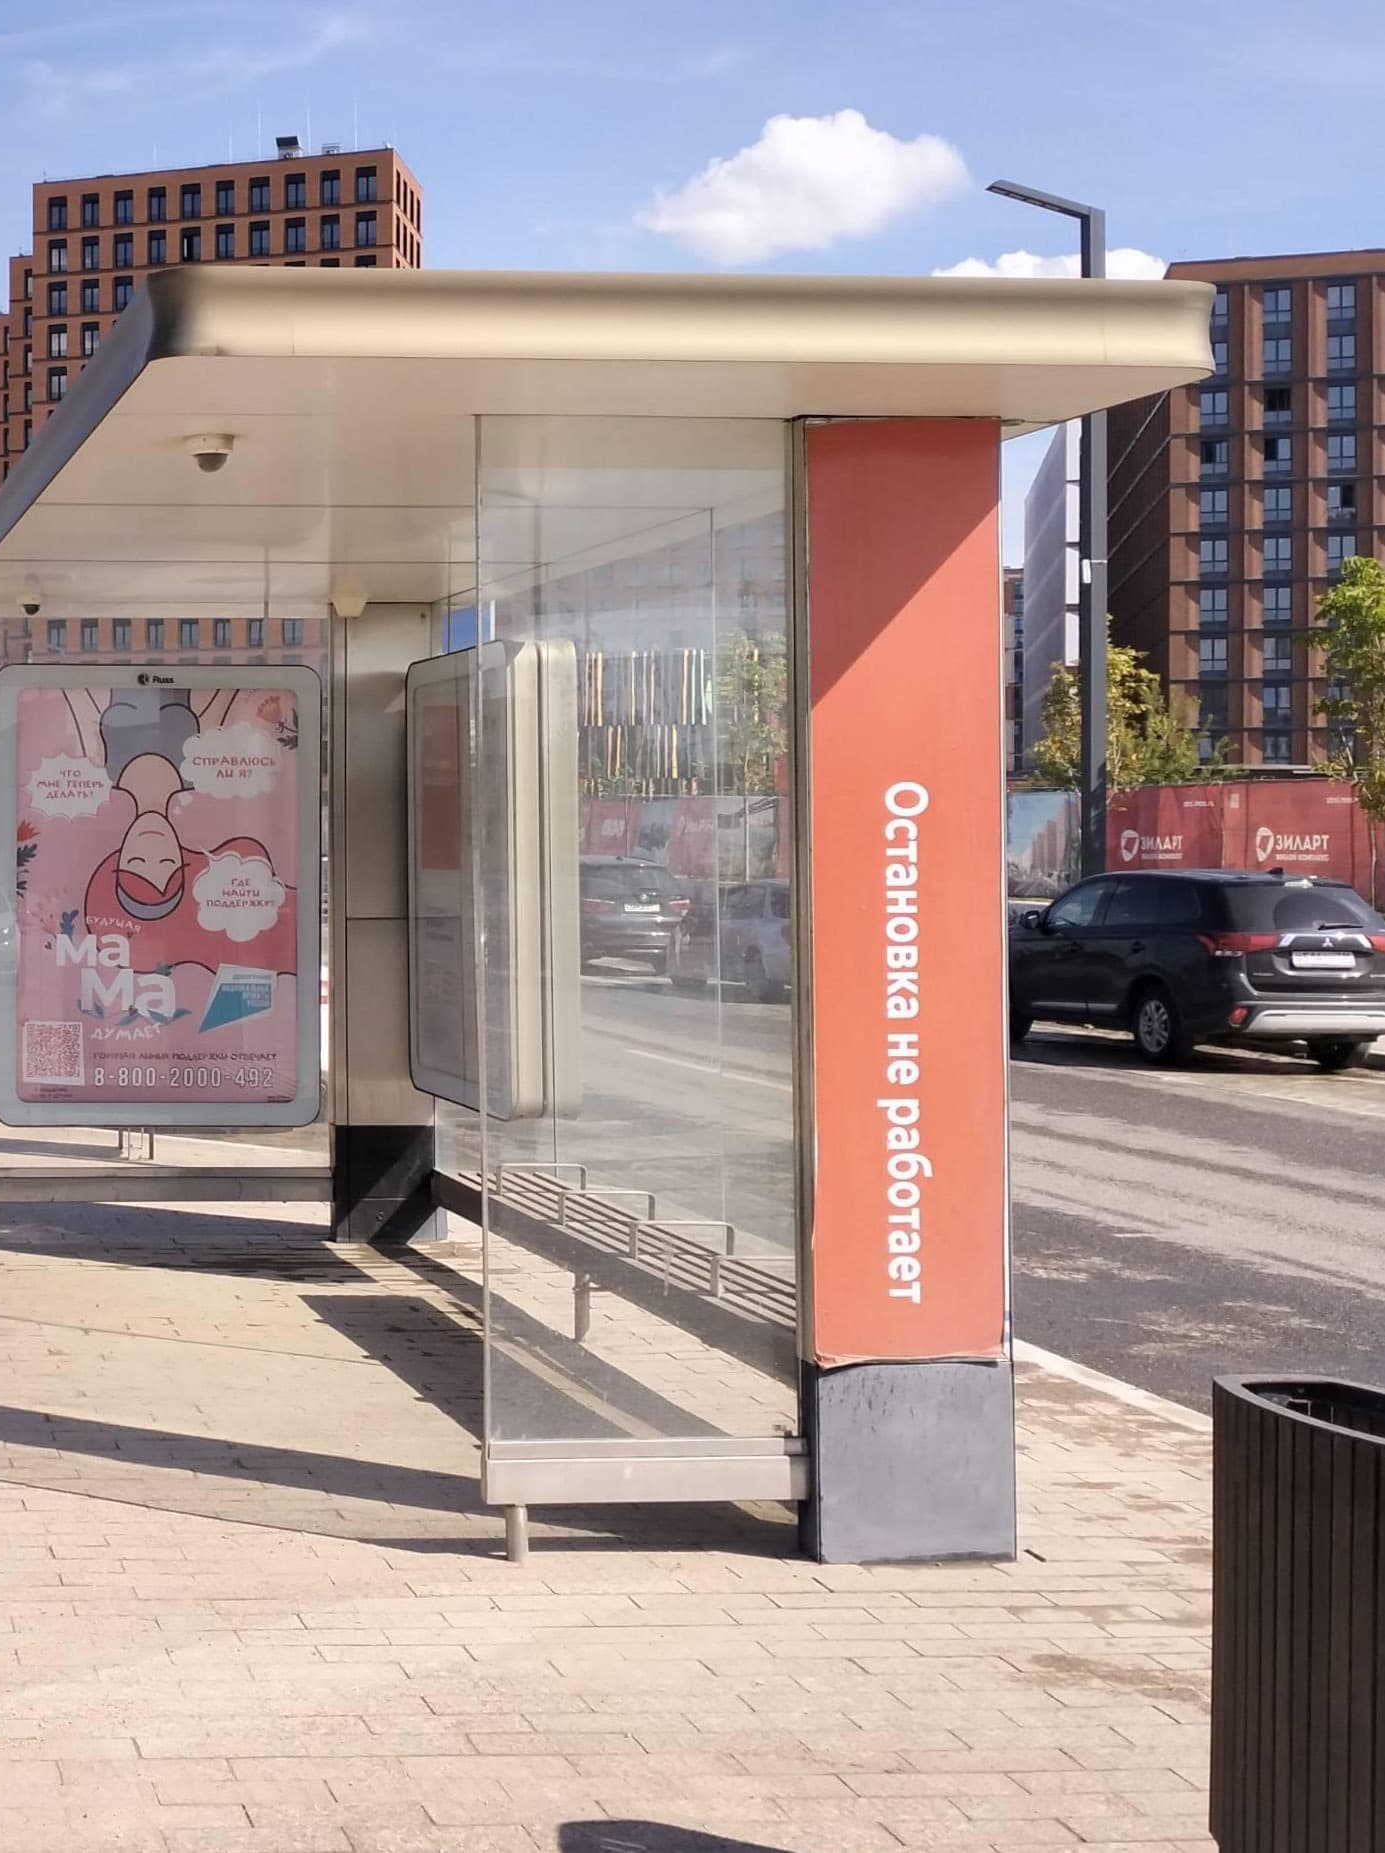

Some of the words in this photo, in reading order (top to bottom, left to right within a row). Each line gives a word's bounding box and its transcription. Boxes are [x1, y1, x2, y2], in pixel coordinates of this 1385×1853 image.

[152, 675, 174, 684] Russ
[192, 756, 276, 767] СПРАВЛЮСЬ
[60, 769, 81, 778] ЧТО
[216, 770, 232, 779] ЛИ
[37, 780, 60, 789] МНЕ
[67, 780, 104, 789] ТЕПЕРЬ
[47, 790, 94, 800] ДЕЛАТЬ?
[1140, 835, 1183, 850] ЗИЛАРТ
[1275, 834, 1330, 851] ЗИЛАРТ
[231, 879, 249, 887] ГДЕ
[222, 889, 260, 897] НАЙТИ
[884, 780, 930, 1020] Остановка
[91, 1022, 161, 1041] ДУМАЕТ
[886, 1033, 920, 1086] не
[94, 1067, 275, 1088] 8-800-2000-492
[876, 1097, 933, 1305] работает
